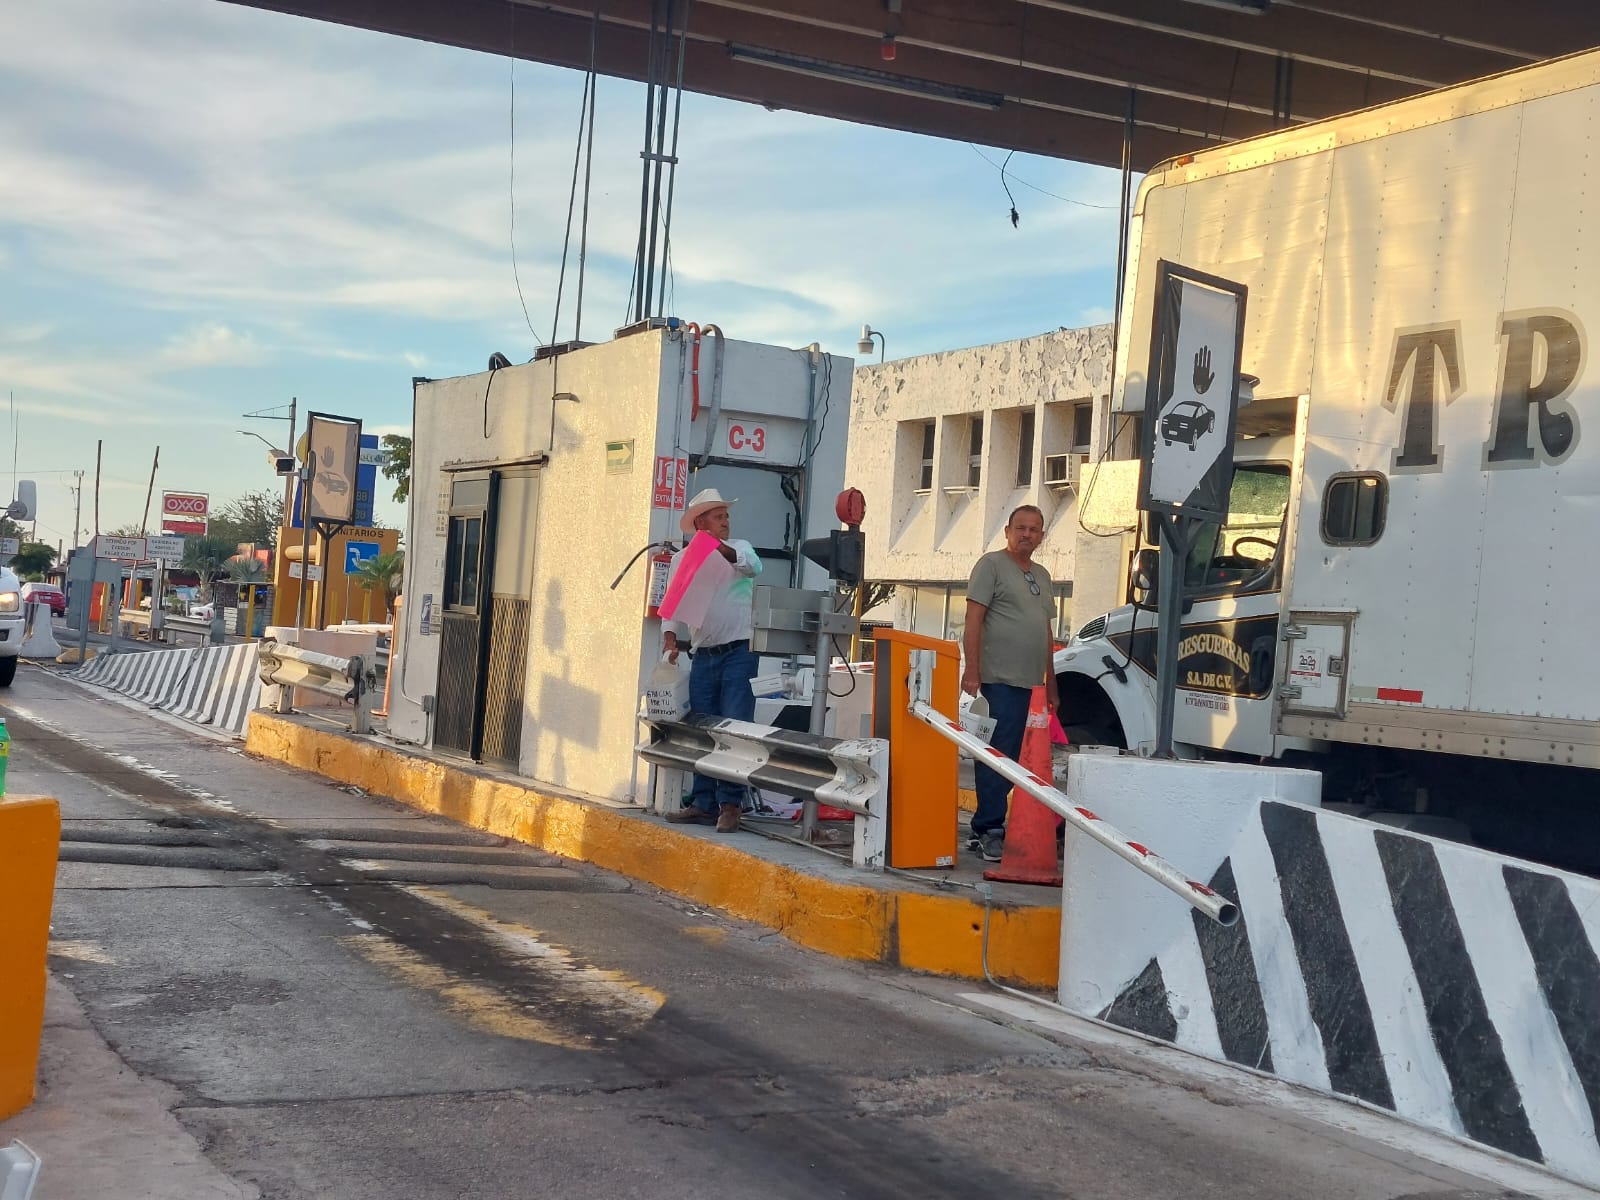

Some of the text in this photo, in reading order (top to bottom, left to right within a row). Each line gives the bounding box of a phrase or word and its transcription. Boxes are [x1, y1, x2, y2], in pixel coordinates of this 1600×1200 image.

[1380, 306, 1589, 475] TR
[729, 425, 765, 452] C-3
[167, 499, 205, 512] OXXO
[655, 493, 684, 504] EXTINOR
[1177, 634, 1250, 674] RESGUERRAS
